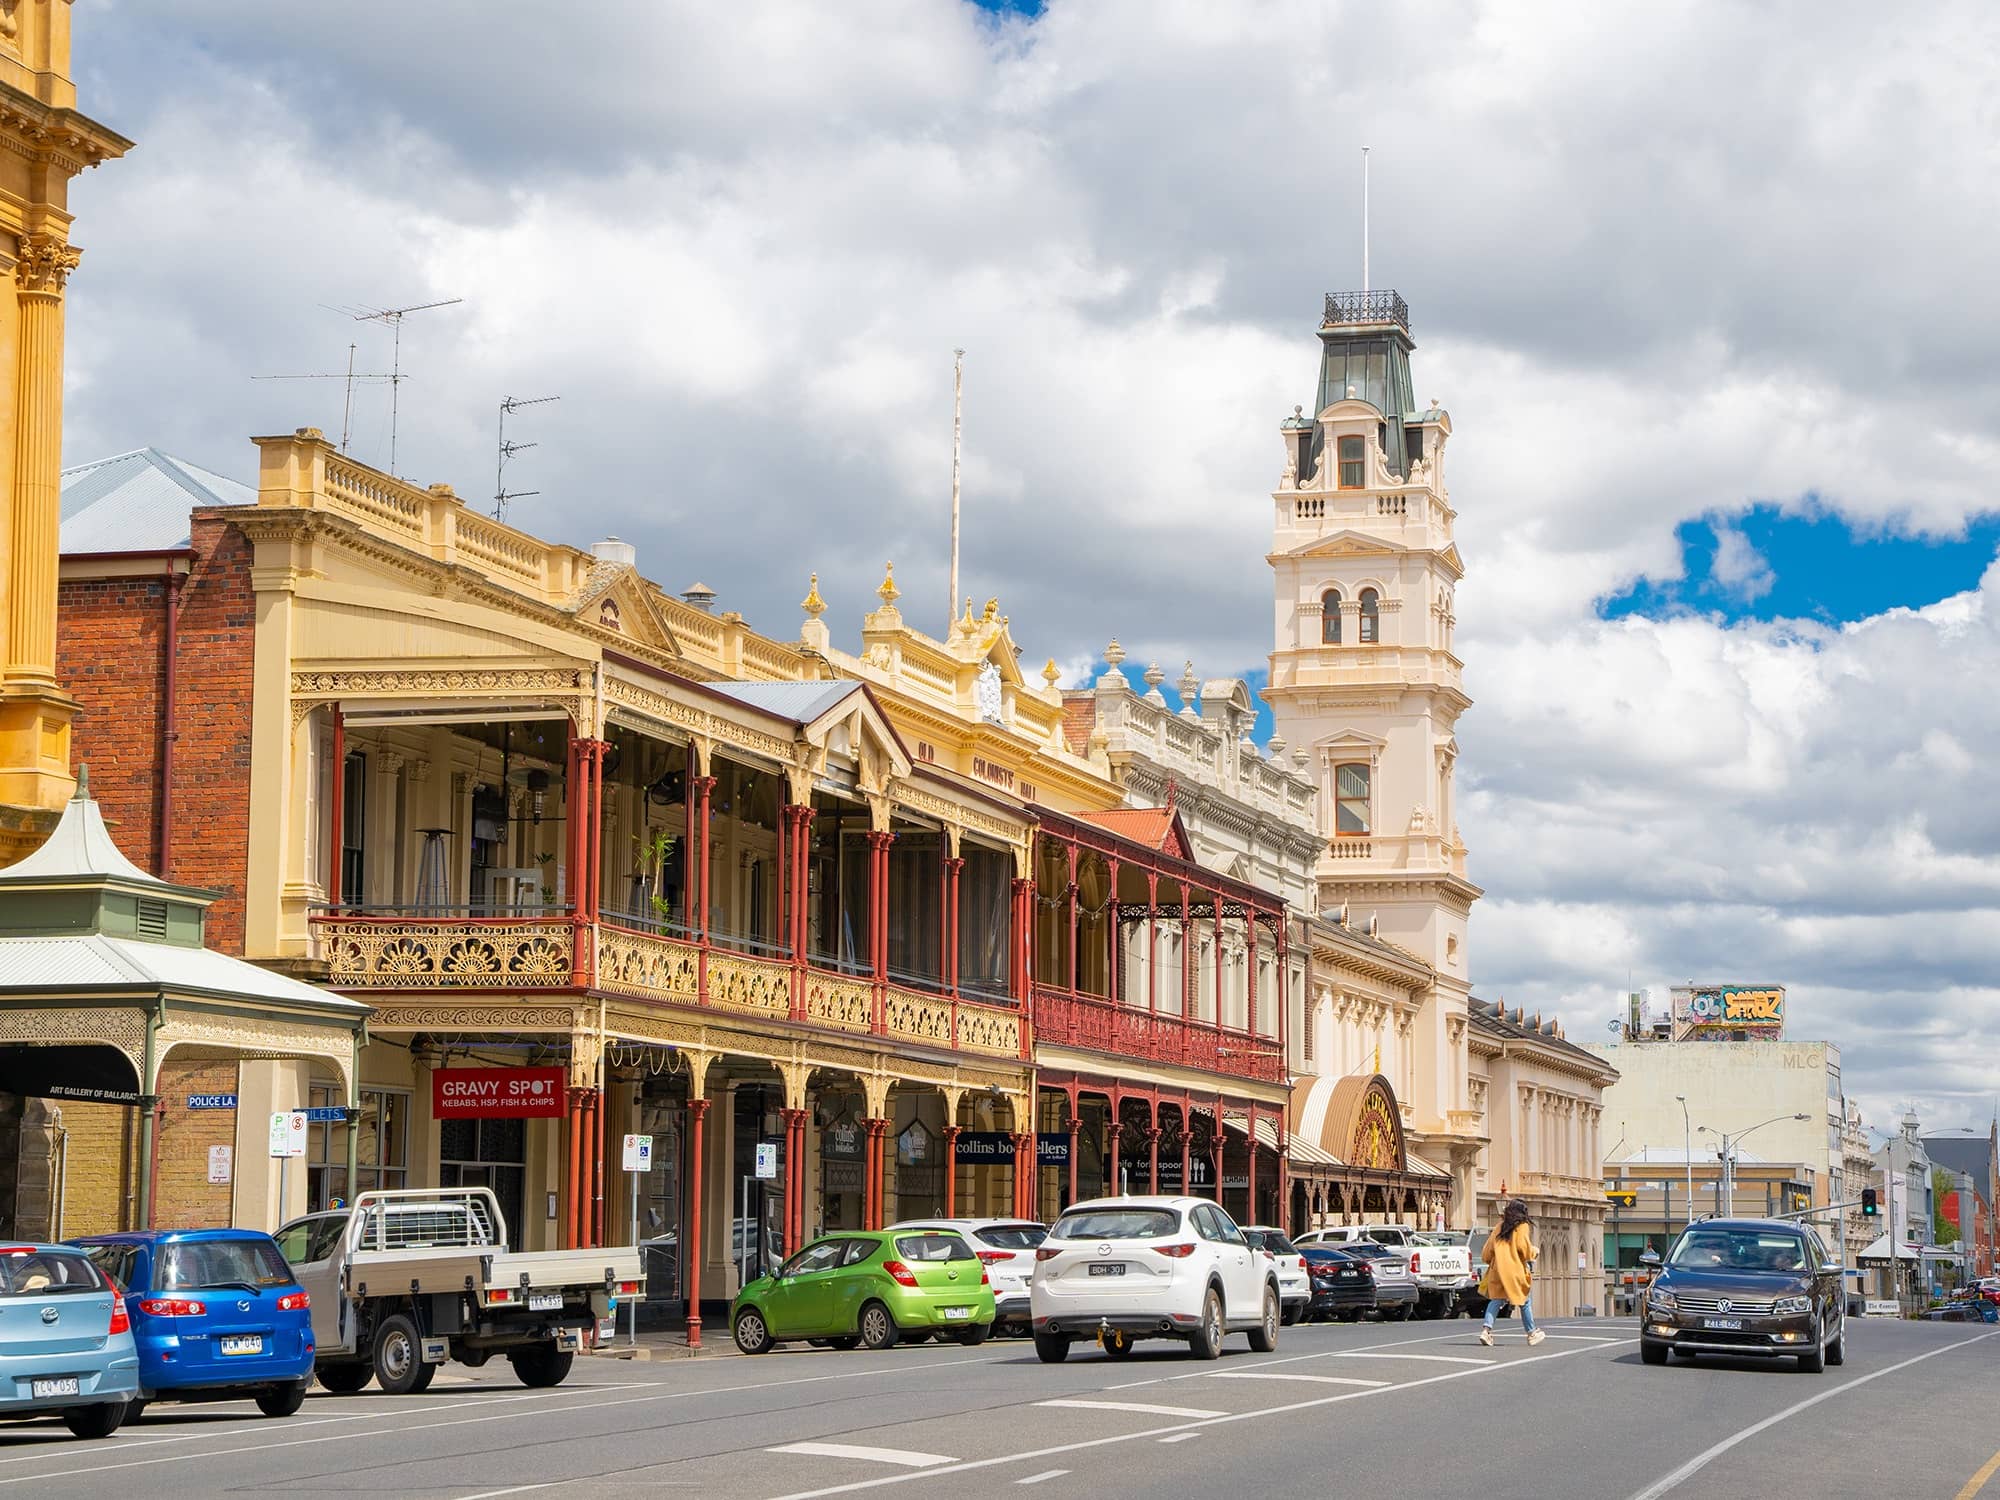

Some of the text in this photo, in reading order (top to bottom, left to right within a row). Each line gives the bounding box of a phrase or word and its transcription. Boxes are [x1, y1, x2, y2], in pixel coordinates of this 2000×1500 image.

[918, 741, 935, 762] OLD
[1783, 1054, 1819, 1069] MLC
[50, 1086, 64, 1094] ART
[64, 1087, 94, 1097] GALLERY
[94, 1089, 103, 1097] OF
[442, 1080, 555, 1096] GRAVY SPOT
[189, 1096, 220, 1106] POLICE
[442, 1097, 555, 1108] KEBABS, HSP, FISH & CHIPS
[639, 1137, 652, 1146] 2P
[955, 1141, 995, 1154] collins
[1429, 1260, 1461, 1270] TOYOTA
